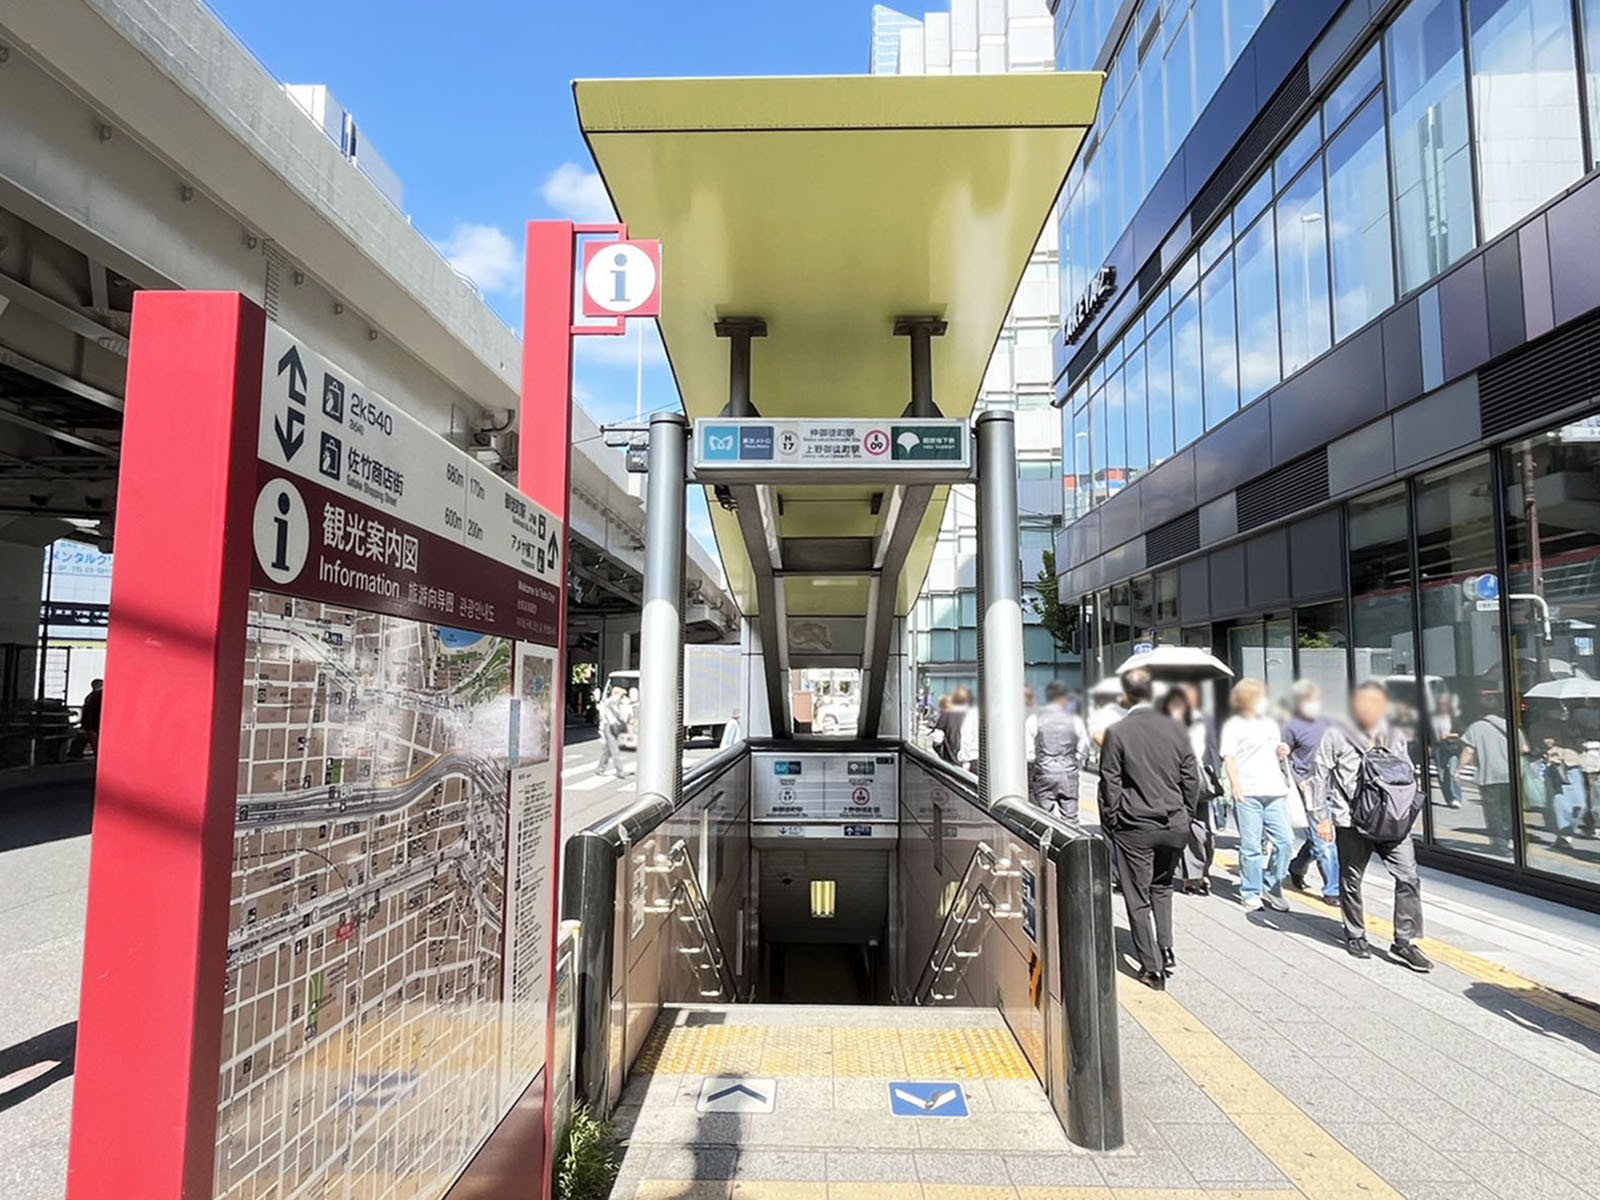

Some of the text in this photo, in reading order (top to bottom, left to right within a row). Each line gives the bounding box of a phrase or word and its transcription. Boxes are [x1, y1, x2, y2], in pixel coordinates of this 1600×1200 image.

[350, 392, 393, 436] 2k540
[870, 442, 883, 450] 09
[348, 447, 404, 496] 佐竹商店街
[322, 502, 419, 574] 観光案内図
[319, 556, 400, 598] Information
